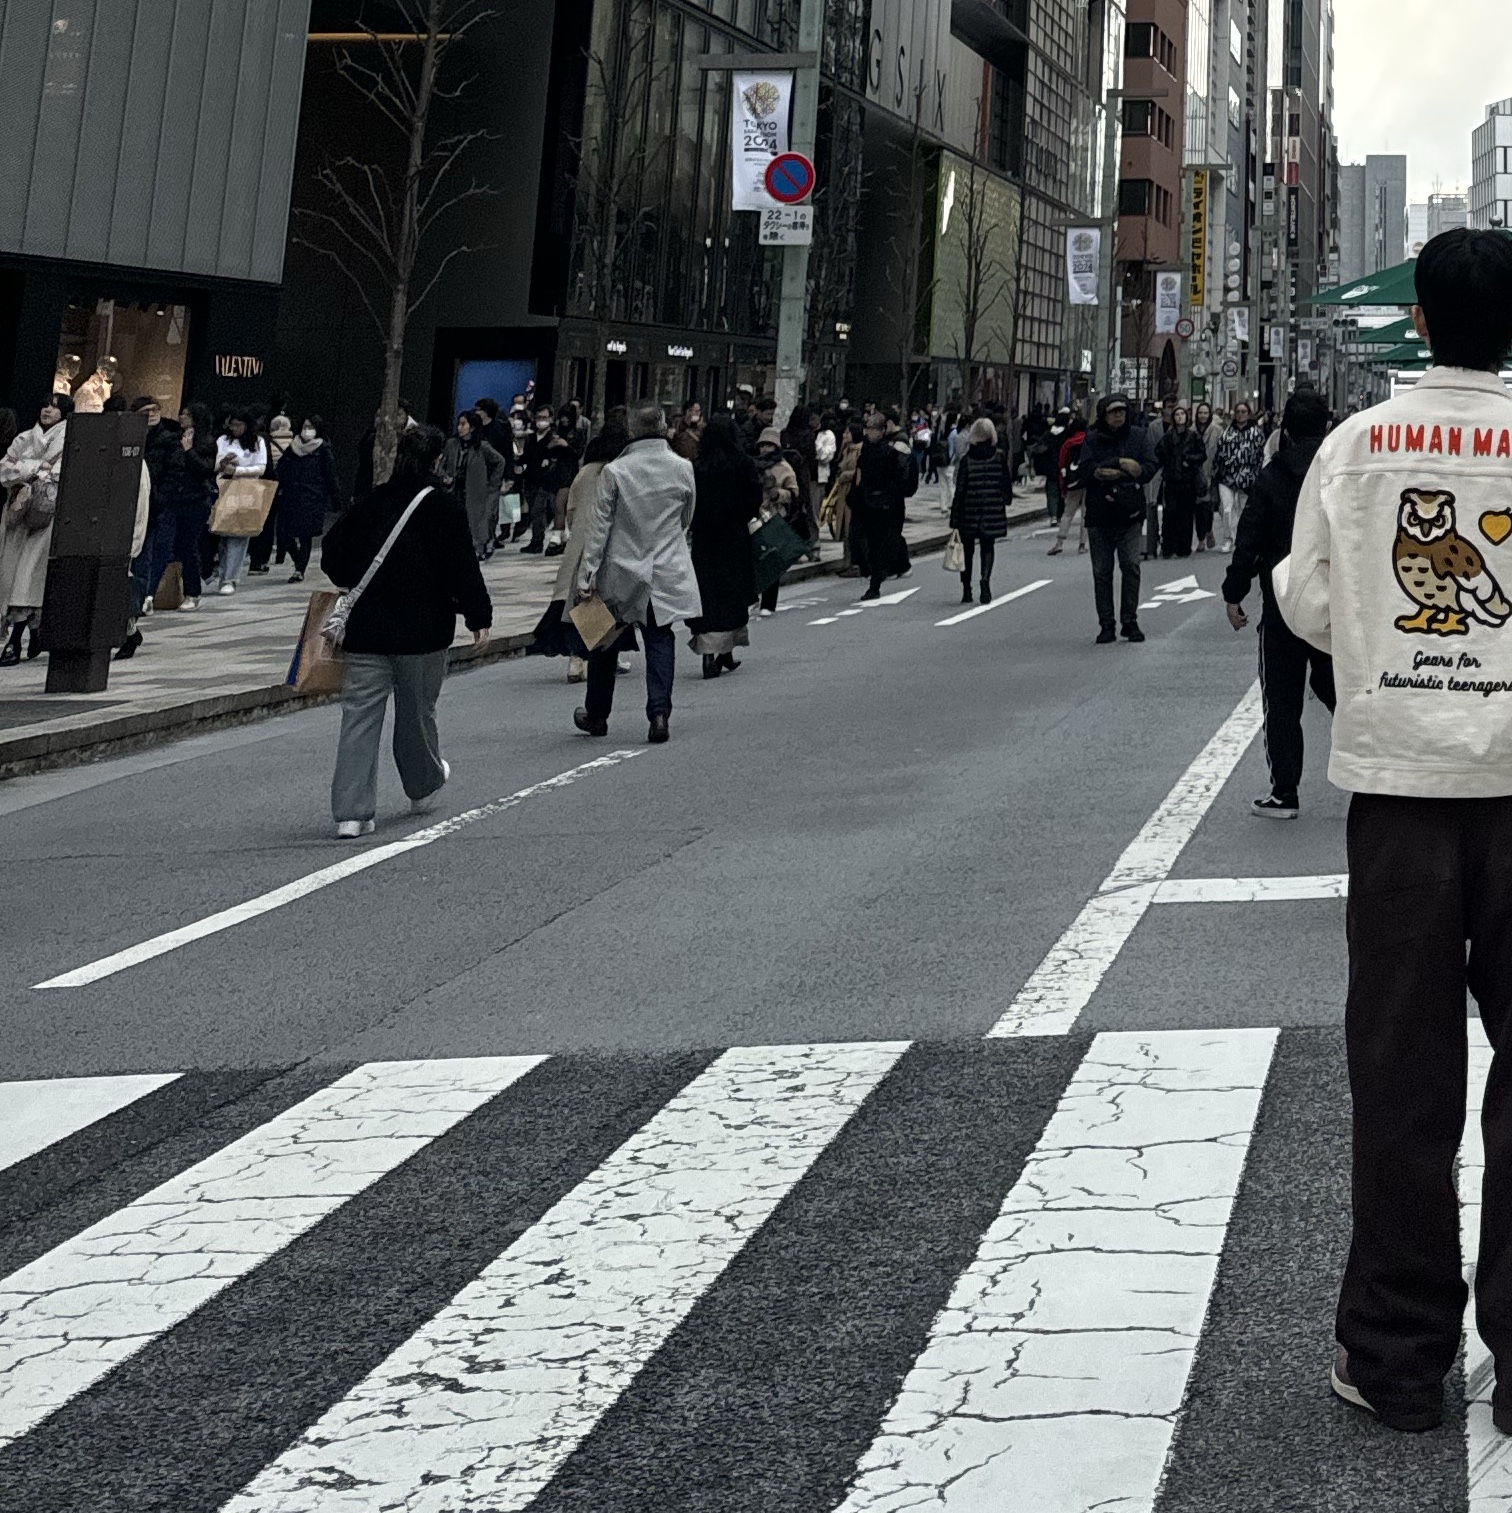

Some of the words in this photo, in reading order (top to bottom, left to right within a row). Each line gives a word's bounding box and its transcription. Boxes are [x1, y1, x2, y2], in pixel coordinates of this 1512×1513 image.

[1370, 425, 1462, 457] HUMAN
[1412, 650, 1454, 670] Gears
[1456, 652, 1482, 670] for
[1379, 671, 1444, 691] futuristic
